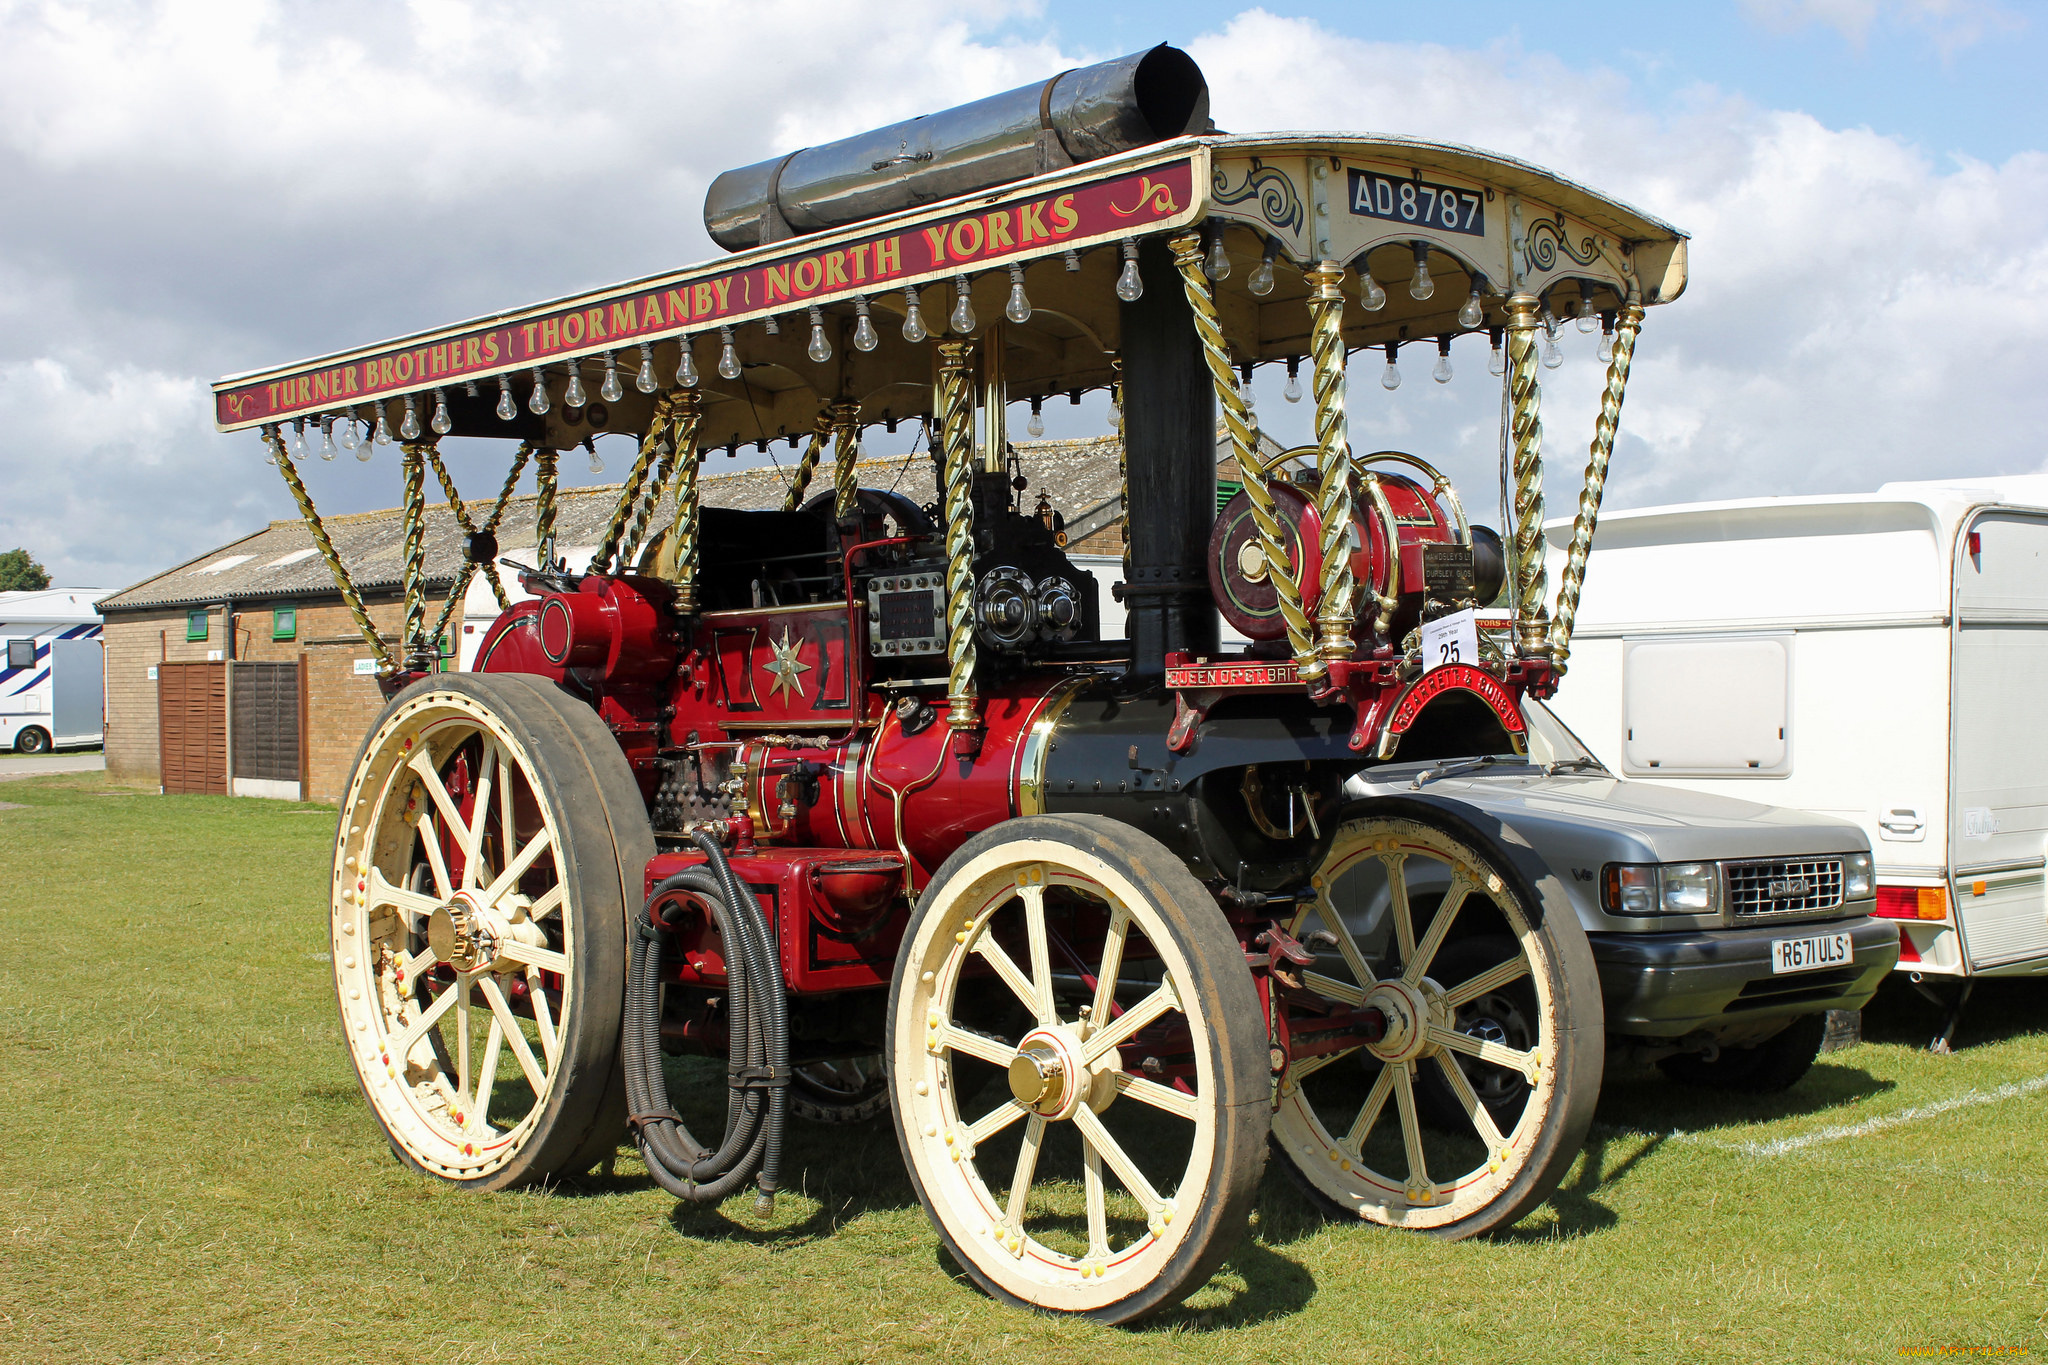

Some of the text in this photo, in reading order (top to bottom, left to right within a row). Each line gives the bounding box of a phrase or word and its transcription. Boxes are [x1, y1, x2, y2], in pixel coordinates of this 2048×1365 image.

[269, 193, 1080, 409] TURNER BROTHERS THORMANBY NORTH YORKS
[1440, 640, 1460, 664] 25
[1169, 669, 1218, 685] QUEEN
[1220, 669, 1240, 684] OF
[1267, 667, 1299, 683] BRIT
[1463, 669, 1472, 686] &
[1477, 675, 1508, 715] SONS
[1571, 868, 1593, 881] V6
[1769, 880, 1810, 897] ISUZU
[1819, 936, 1845, 962] ULS
